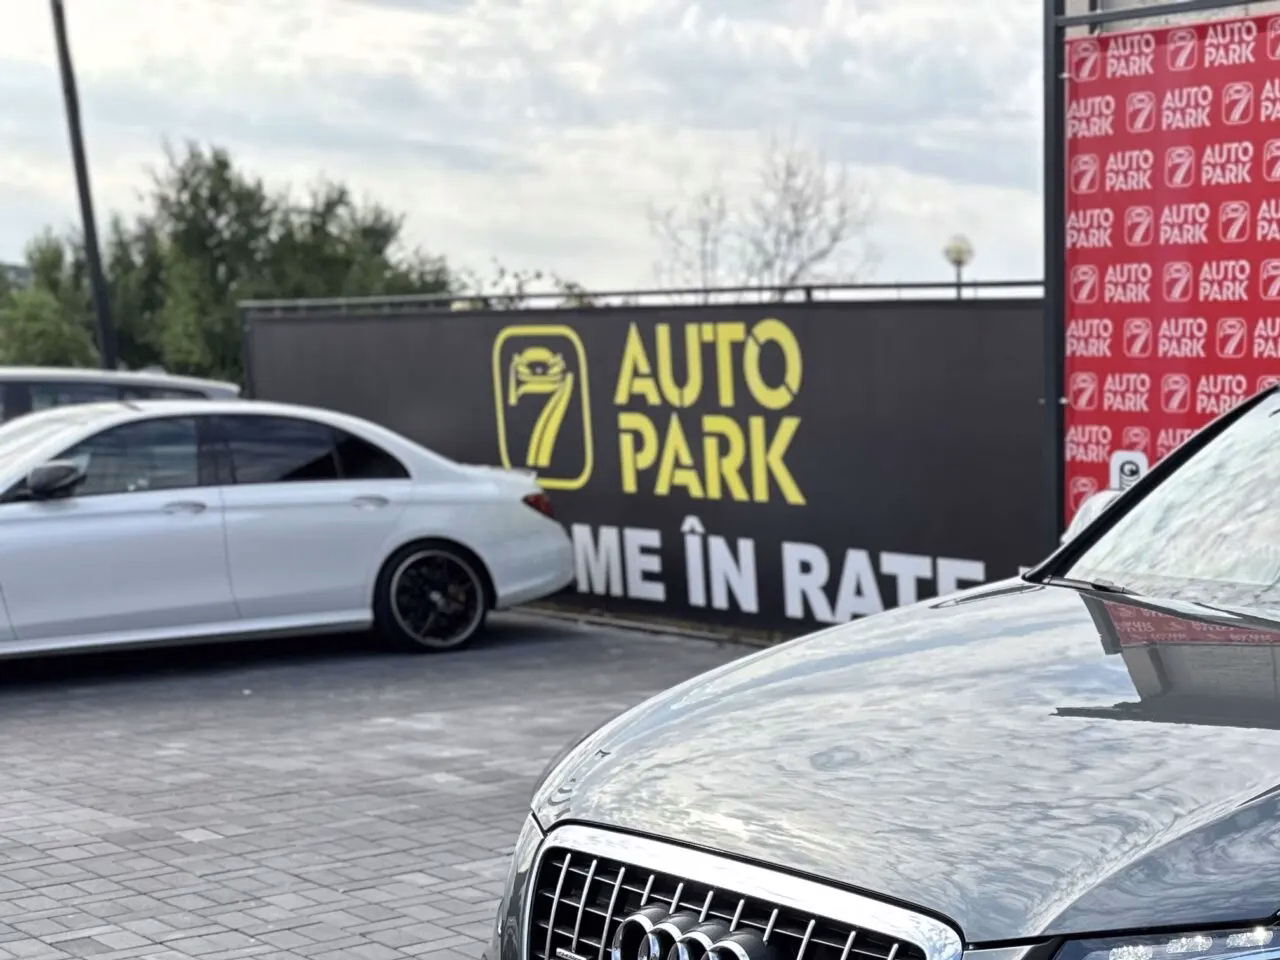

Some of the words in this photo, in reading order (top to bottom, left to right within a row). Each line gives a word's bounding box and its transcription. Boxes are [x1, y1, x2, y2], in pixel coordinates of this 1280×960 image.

[1205, 21, 1257, 46] AUTO
[1106, 34, 1155, 57] AUTO
[1204, 43, 1256, 67] PARK
[1106, 55, 1153, 78] PARK
[1067, 95, 1115, 118] AUTO
[1162, 85, 1212, 109] AUTO
[1067, 115, 1114, 138] PARK
[1161, 107, 1211, 130] PARK
[1105, 150, 1153, 173] AUTO
[1201, 142, 1253, 165] AUTO
[1105, 170, 1152, 191] PARK
[1201, 163, 1251, 186] PARK
[1067, 208, 1113, 229] AUTO
[1161, 203, 1210, 225] AUTO
[1066, 227, 1112, 247] PARK
[1159, 222, 1209, 244] PARK
[1105, 263, 1152, 284] AUTO
[1200, 260, 1250, 281] AUTO
[1104, 283, 1150, 303] PARK
[1199, 279, 1249, 301] PARK
[1066, 319, 1113, 339] AUTO
[1159, 318, 1208, 339] AUTO
[1065, 337, 1112, 357] PARK
[1158, 336, 1206, 358] PARK
[615, 318, 802, 410] AUTO
[1104, 373, 1150, 394] AUTO
[1197, 375, 1247, 396] AUTO
[1103, 391, 1148, 412] PARK
[1066, 425, 1112, 445] AUTO
[618, 412, 806, 506] PARK
[1065, 443, 1110, 461] PARK
[680, 514, 759, 614] ÎN
